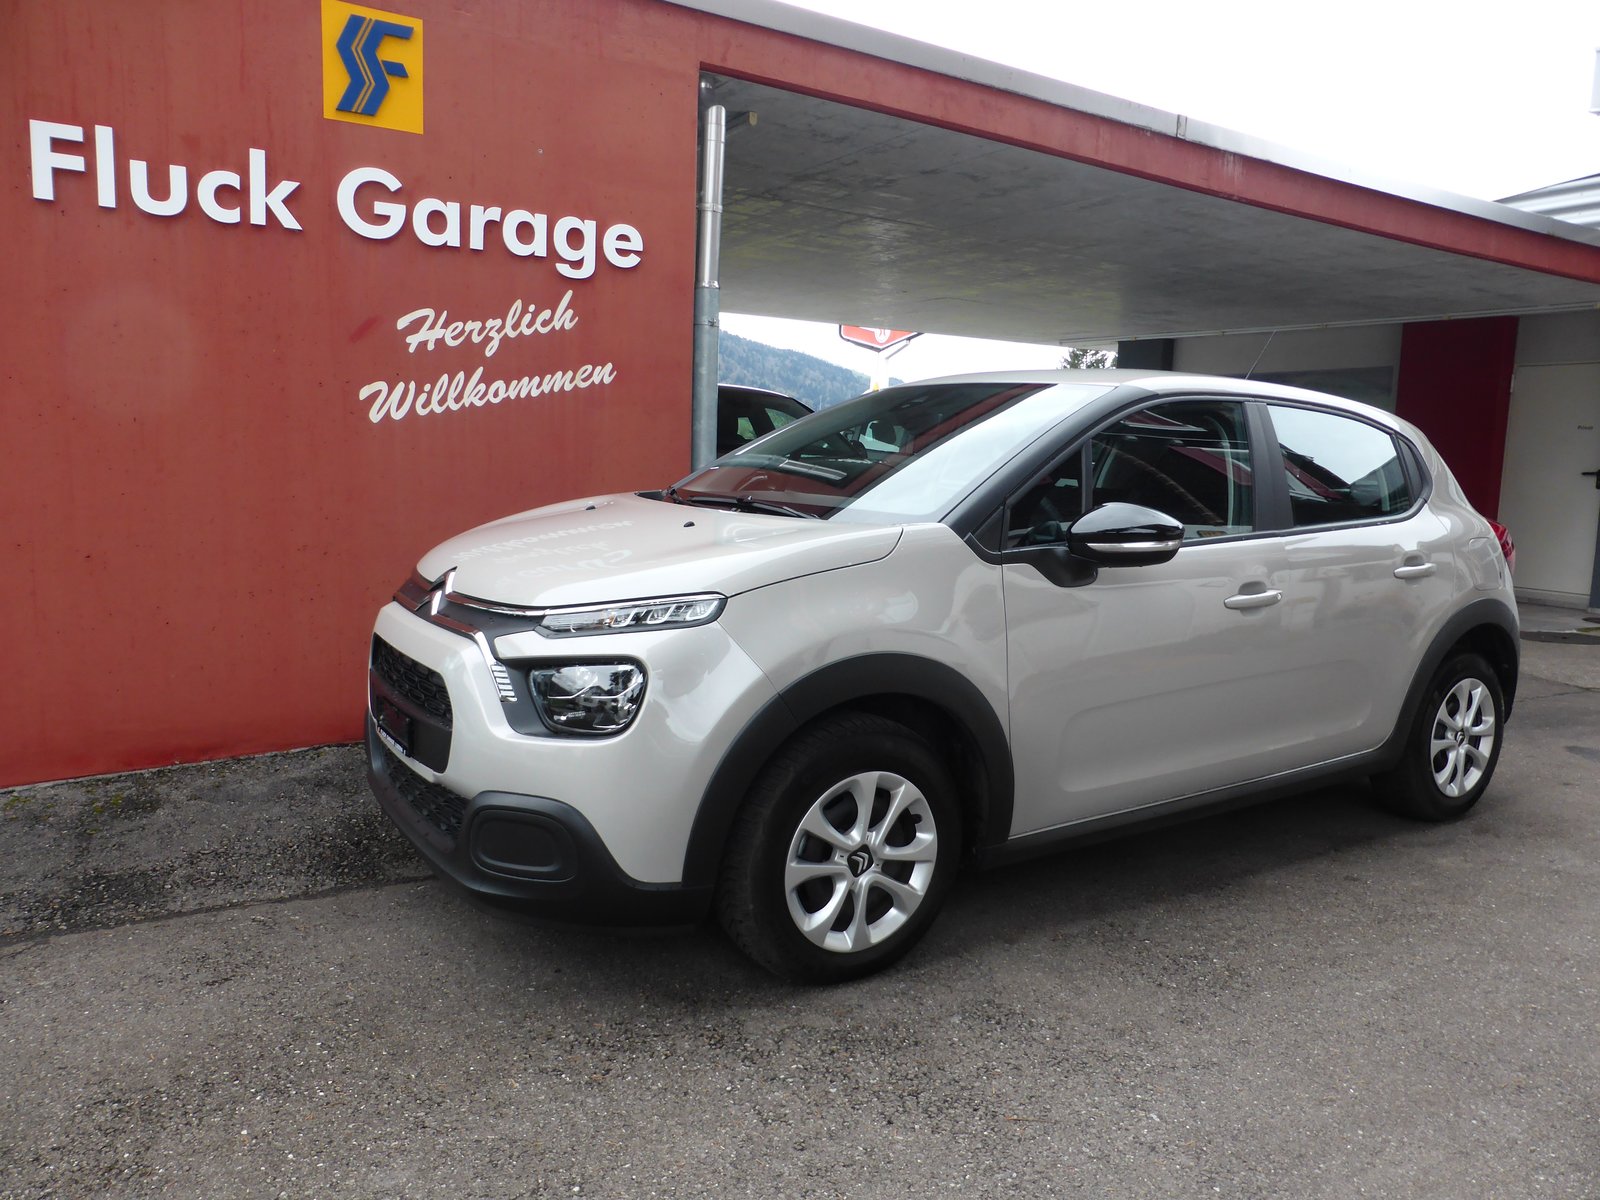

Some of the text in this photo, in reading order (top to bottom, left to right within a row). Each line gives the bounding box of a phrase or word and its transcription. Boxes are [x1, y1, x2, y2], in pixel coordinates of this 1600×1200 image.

[29, 119, 644, 279] Fluck Garage
[397, 290, 578, 357] Herzlich
[359, 362, 617, 423] Willkommen
